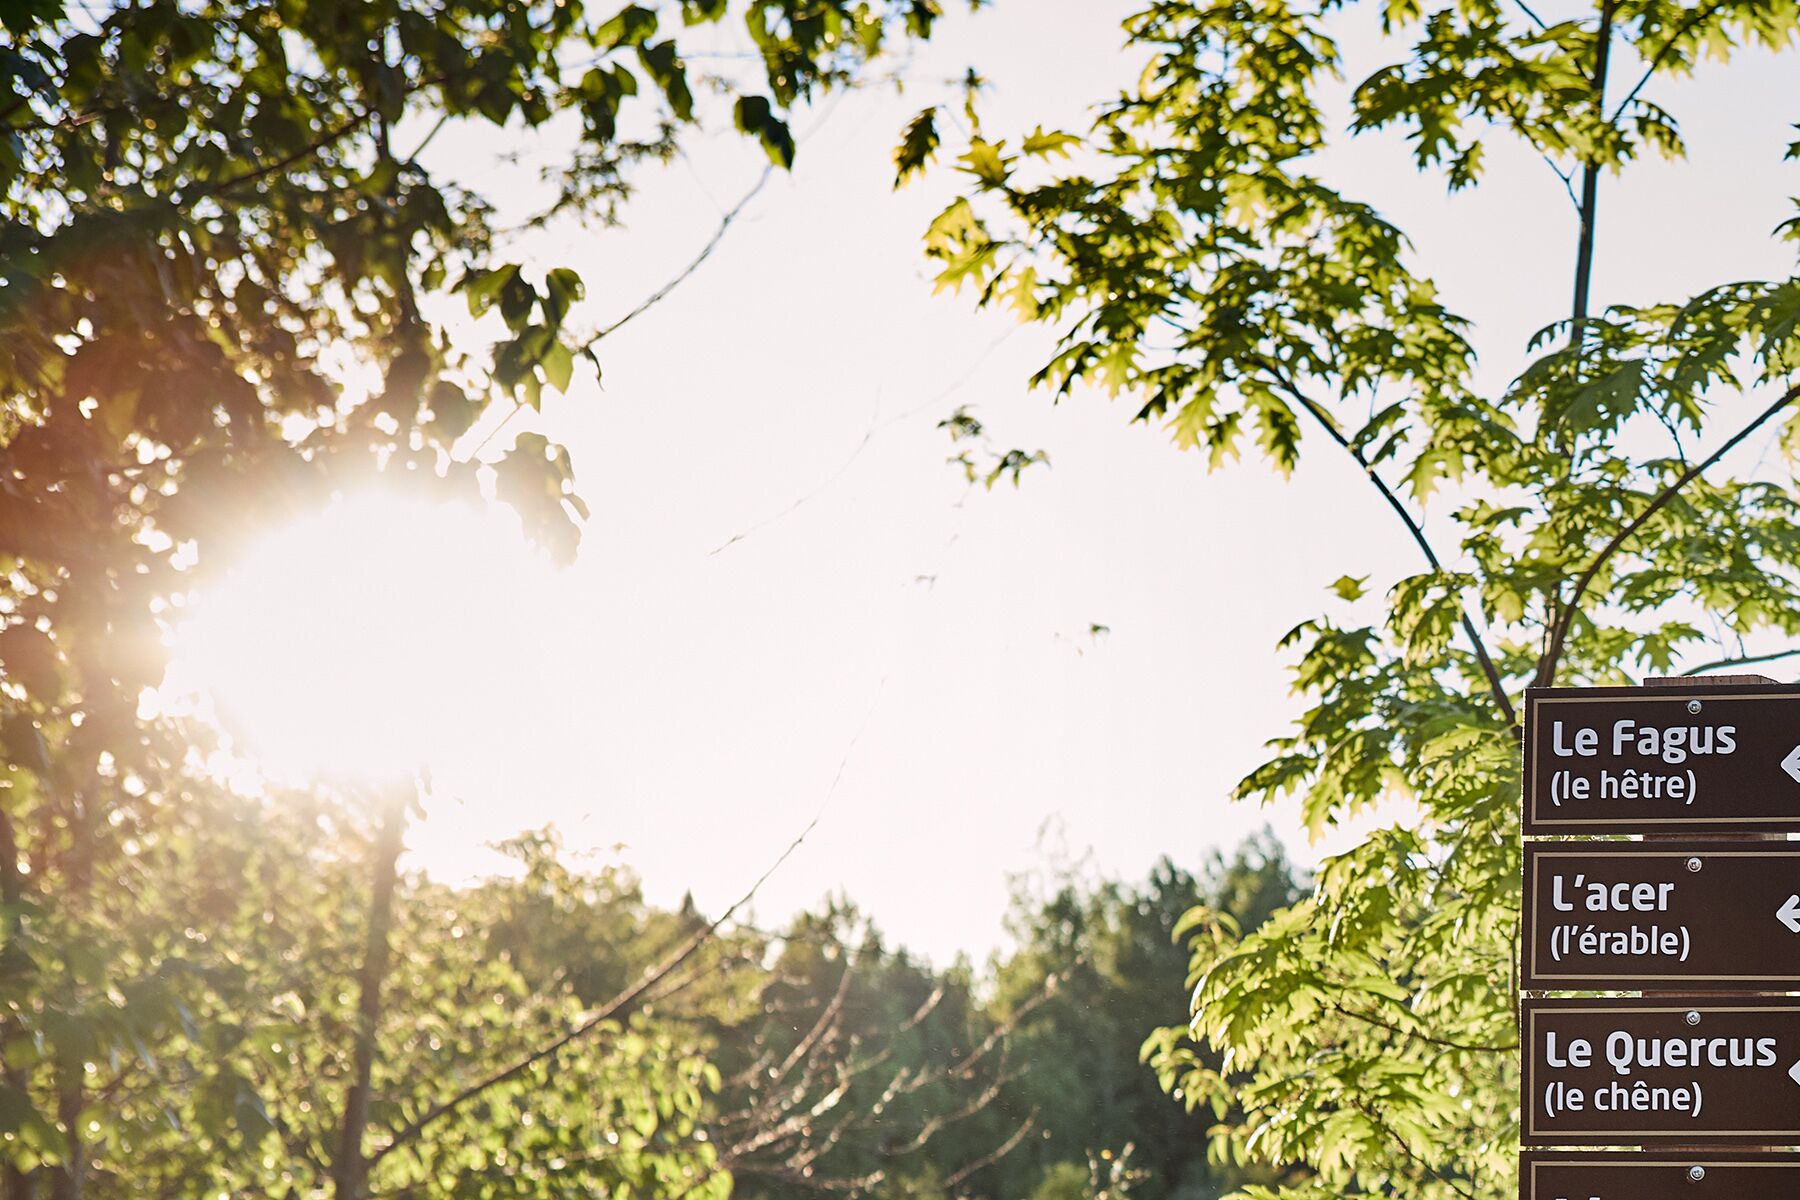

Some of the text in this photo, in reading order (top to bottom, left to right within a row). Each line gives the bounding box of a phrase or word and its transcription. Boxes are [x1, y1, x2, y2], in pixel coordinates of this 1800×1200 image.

[1553, 719, 1737, 764] Le Fagus
[1551, 769, 1696, 807] (le hêtre)
[1553, 874, 1675, 912] L'acer
[1550, 924, 1690, 962] (l'érable)
[1546, 1030, 1777, 1075] Le Quercus
[1545, 1080, 1702, 1118] (le chêne)
